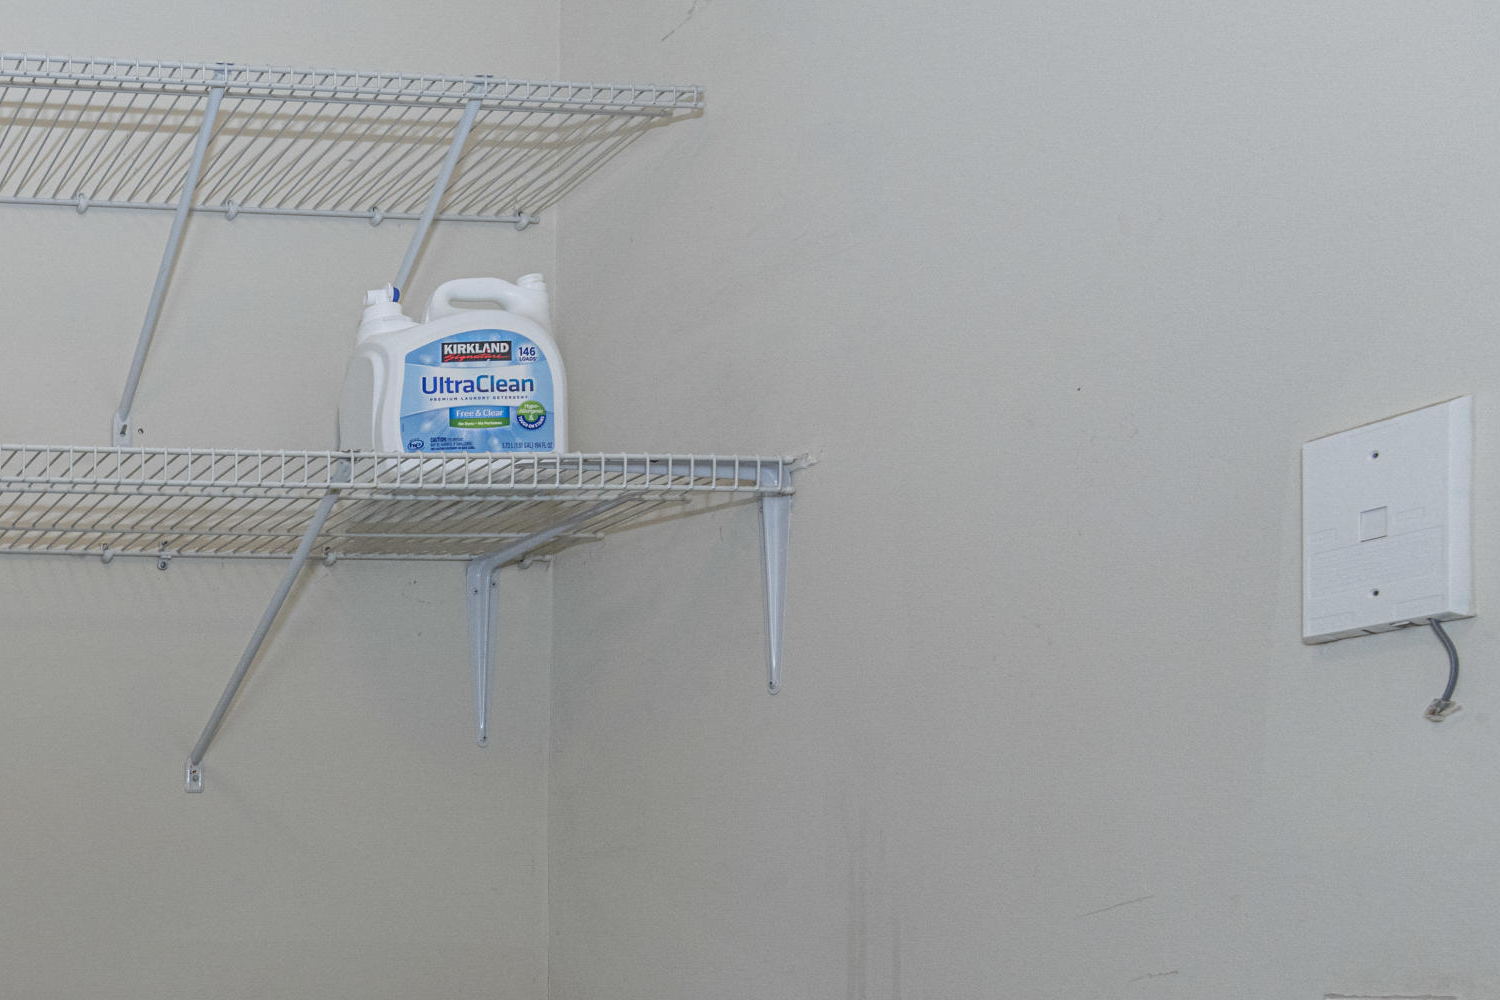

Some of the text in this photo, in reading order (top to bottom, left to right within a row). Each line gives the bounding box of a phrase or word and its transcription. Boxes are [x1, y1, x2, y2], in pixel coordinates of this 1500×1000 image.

[443, 343, 510, 354] KIRKLAND
[518, 347, 536, 356] 146
[422, 374, 534, 394] UltraClean
